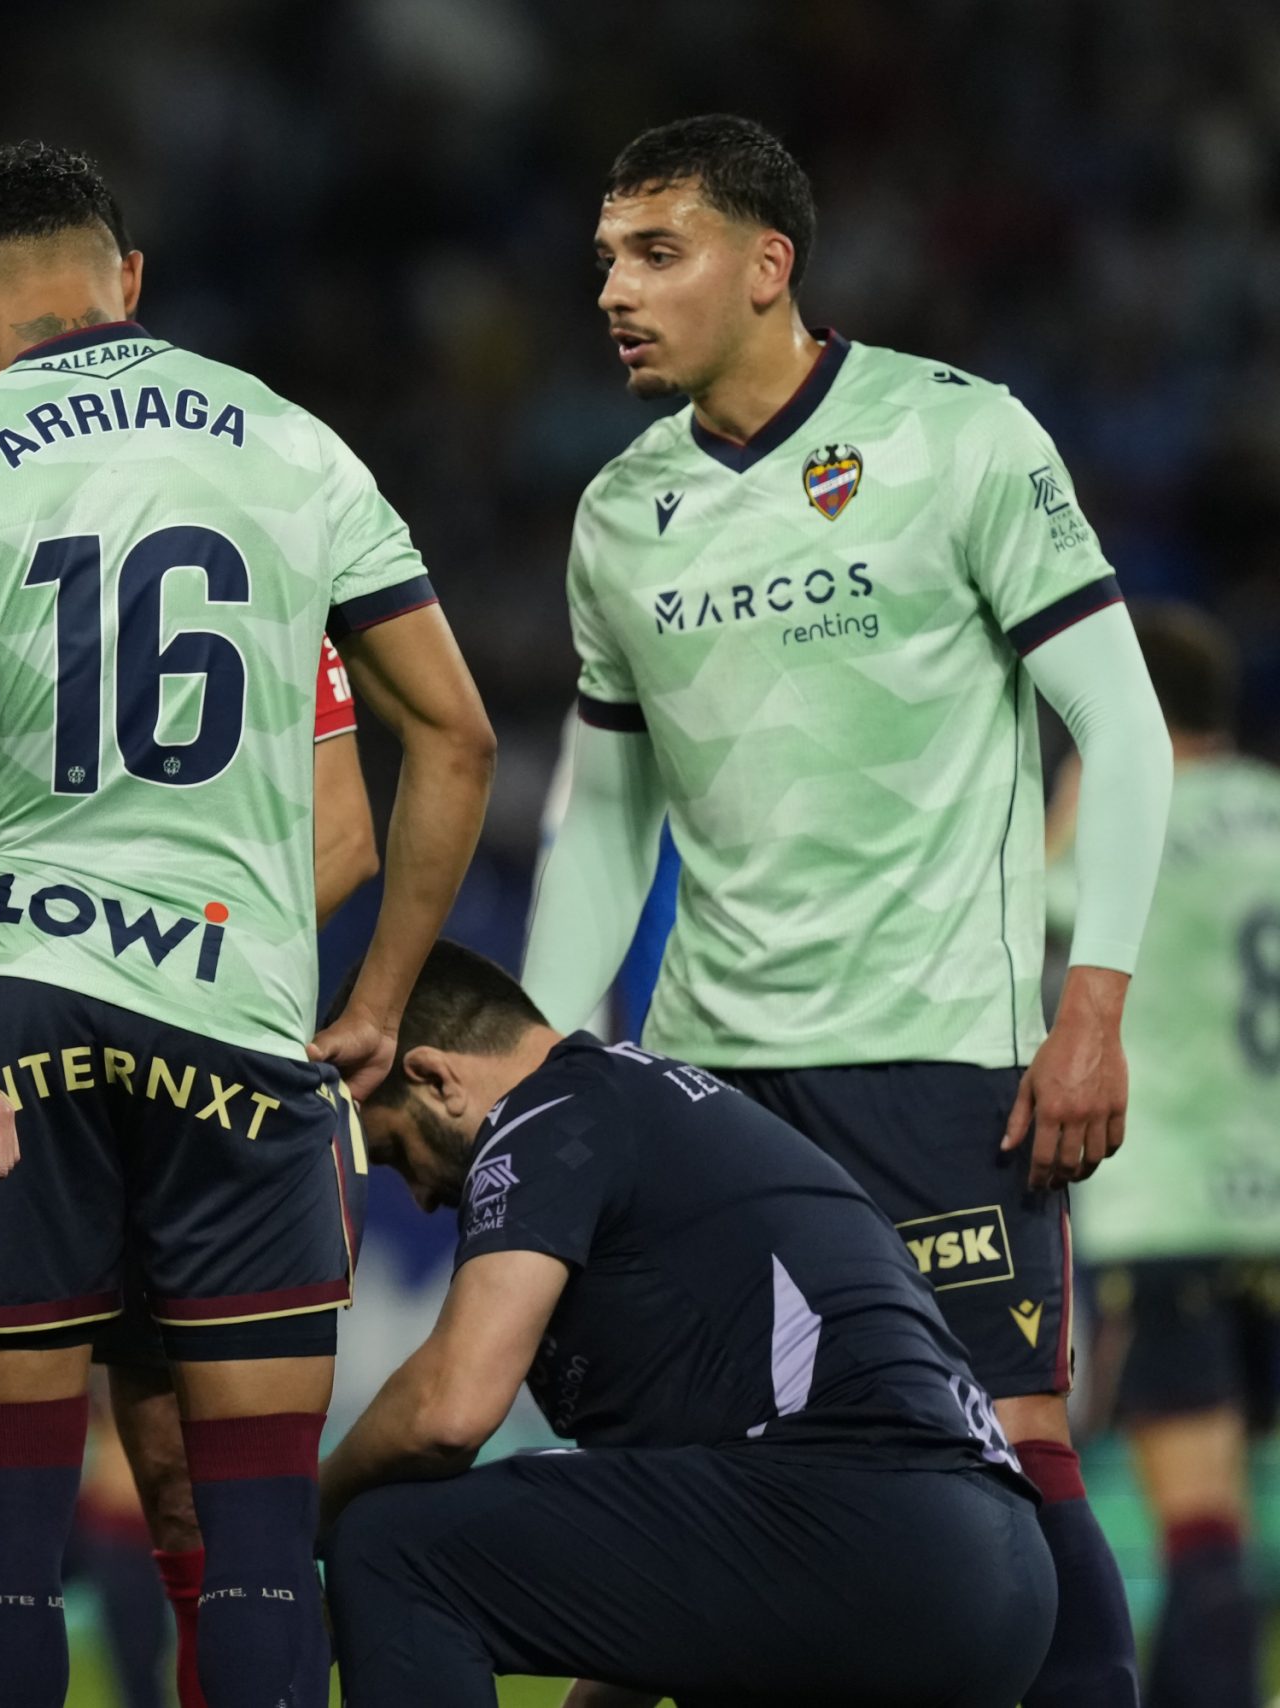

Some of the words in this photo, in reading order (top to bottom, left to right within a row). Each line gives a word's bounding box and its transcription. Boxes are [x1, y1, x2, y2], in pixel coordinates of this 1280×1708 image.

[655, 562, 873, 634] MARCOS
[783, 611, 878, 646] renting
[22, 524, 251, 796] 16
[906, 1225, 1001, 1274] YSK
